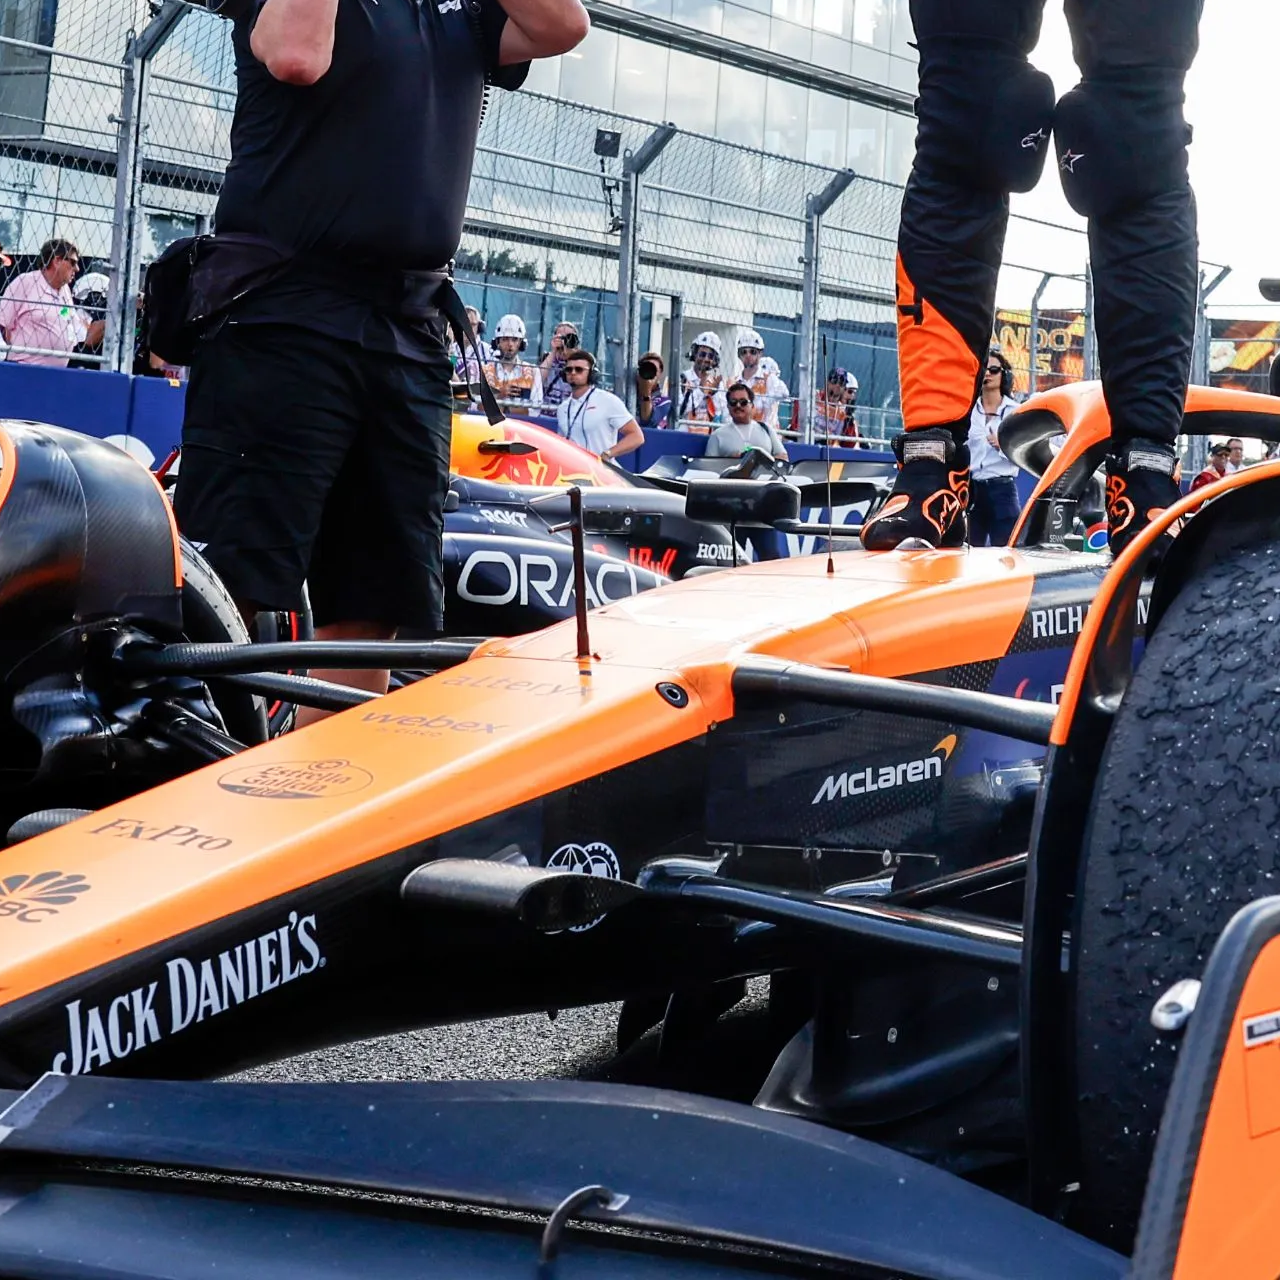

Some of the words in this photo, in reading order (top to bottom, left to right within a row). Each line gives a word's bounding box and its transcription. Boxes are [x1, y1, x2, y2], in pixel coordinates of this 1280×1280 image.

[480, 509, 528, 528] ROKT
[457, 551, 670, 607] ORAC
[1032, 605, 1091, 639] RICH
[443, 675, 599, 697] alteryx
[361, 711, 510, 735] webex
[243, 775, 328, 793] Galicia
[267, 765, 353, 785] Estrella
[812, 756, 943, 805] McLaren
[89, 818, 234, 852] FxPro
[52, 982, 162, 1076] JACK
